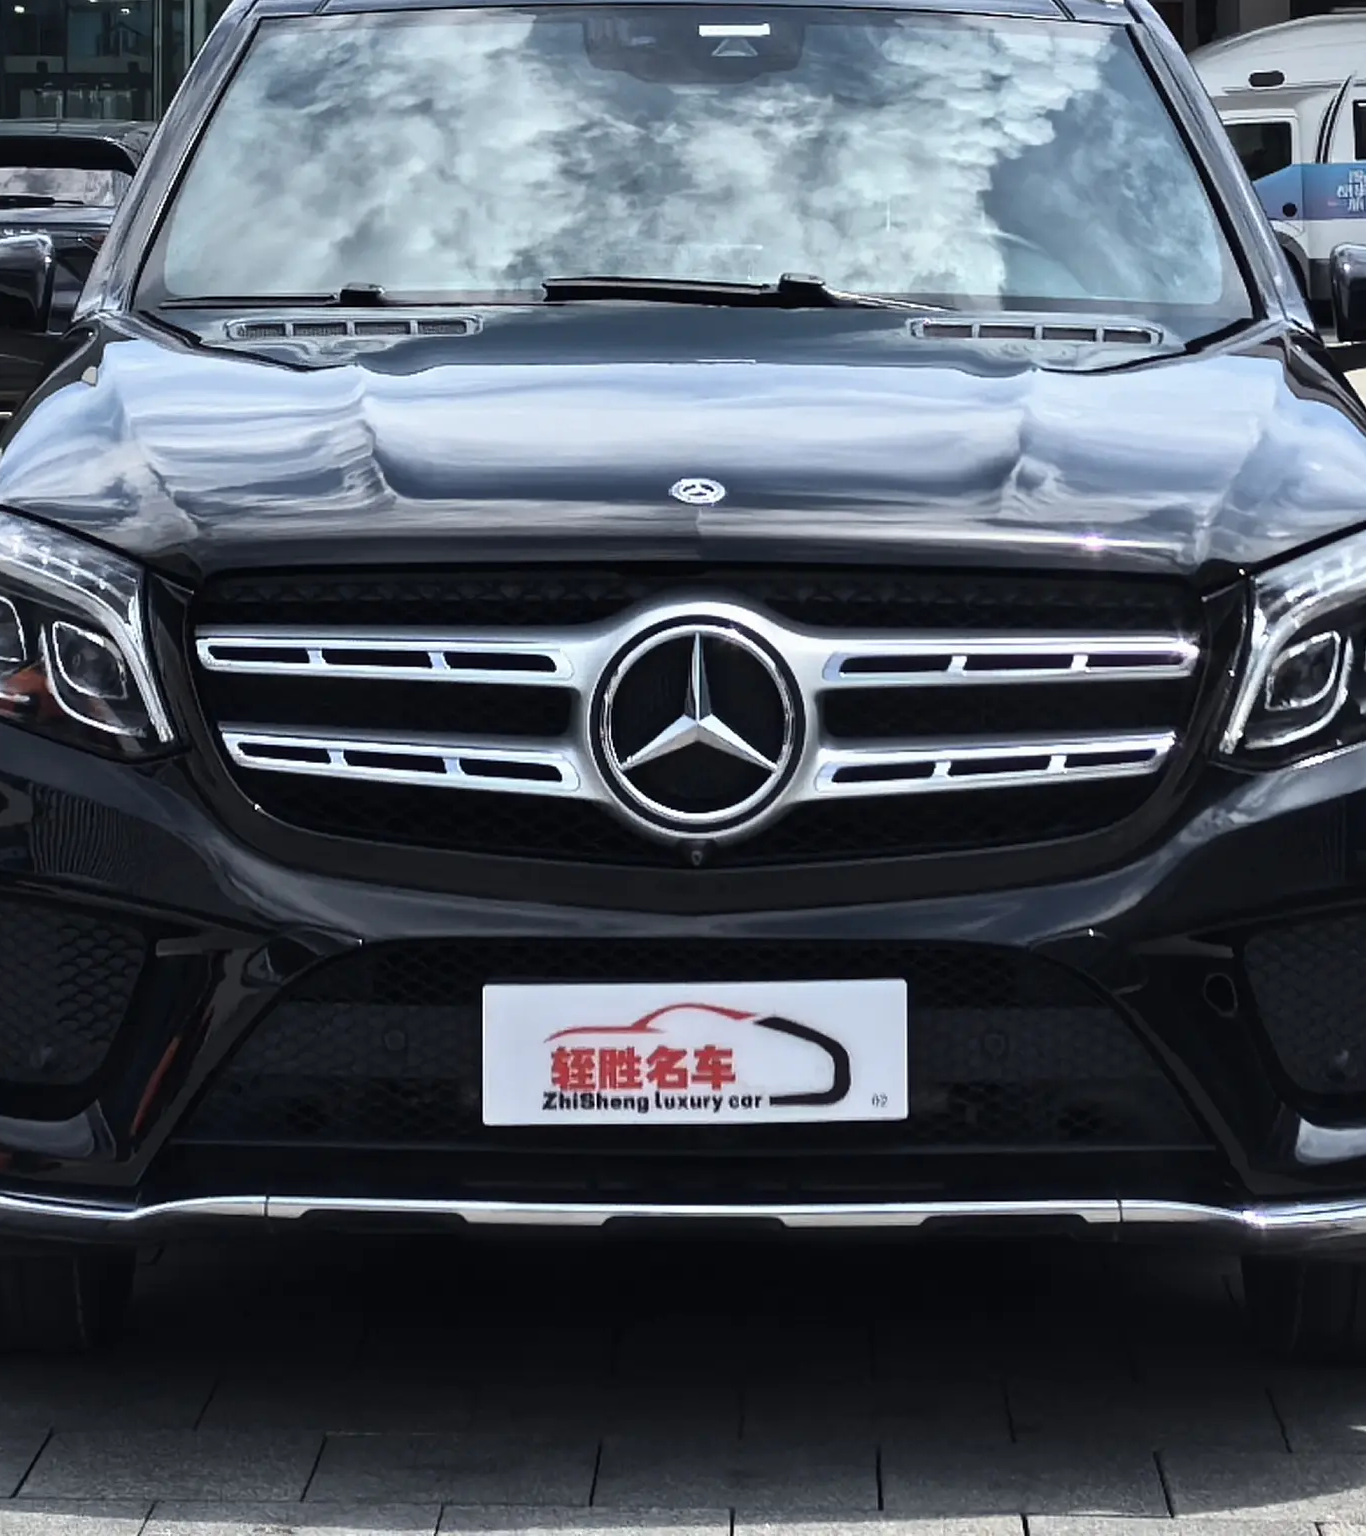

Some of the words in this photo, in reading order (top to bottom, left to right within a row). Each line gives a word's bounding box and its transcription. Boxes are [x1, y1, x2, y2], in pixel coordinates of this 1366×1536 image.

[542, 1091, 649, 1113] ZhiSheng
[655, 1092, 722, 1113] luxury
[729, 1096, 762, 1110] car
